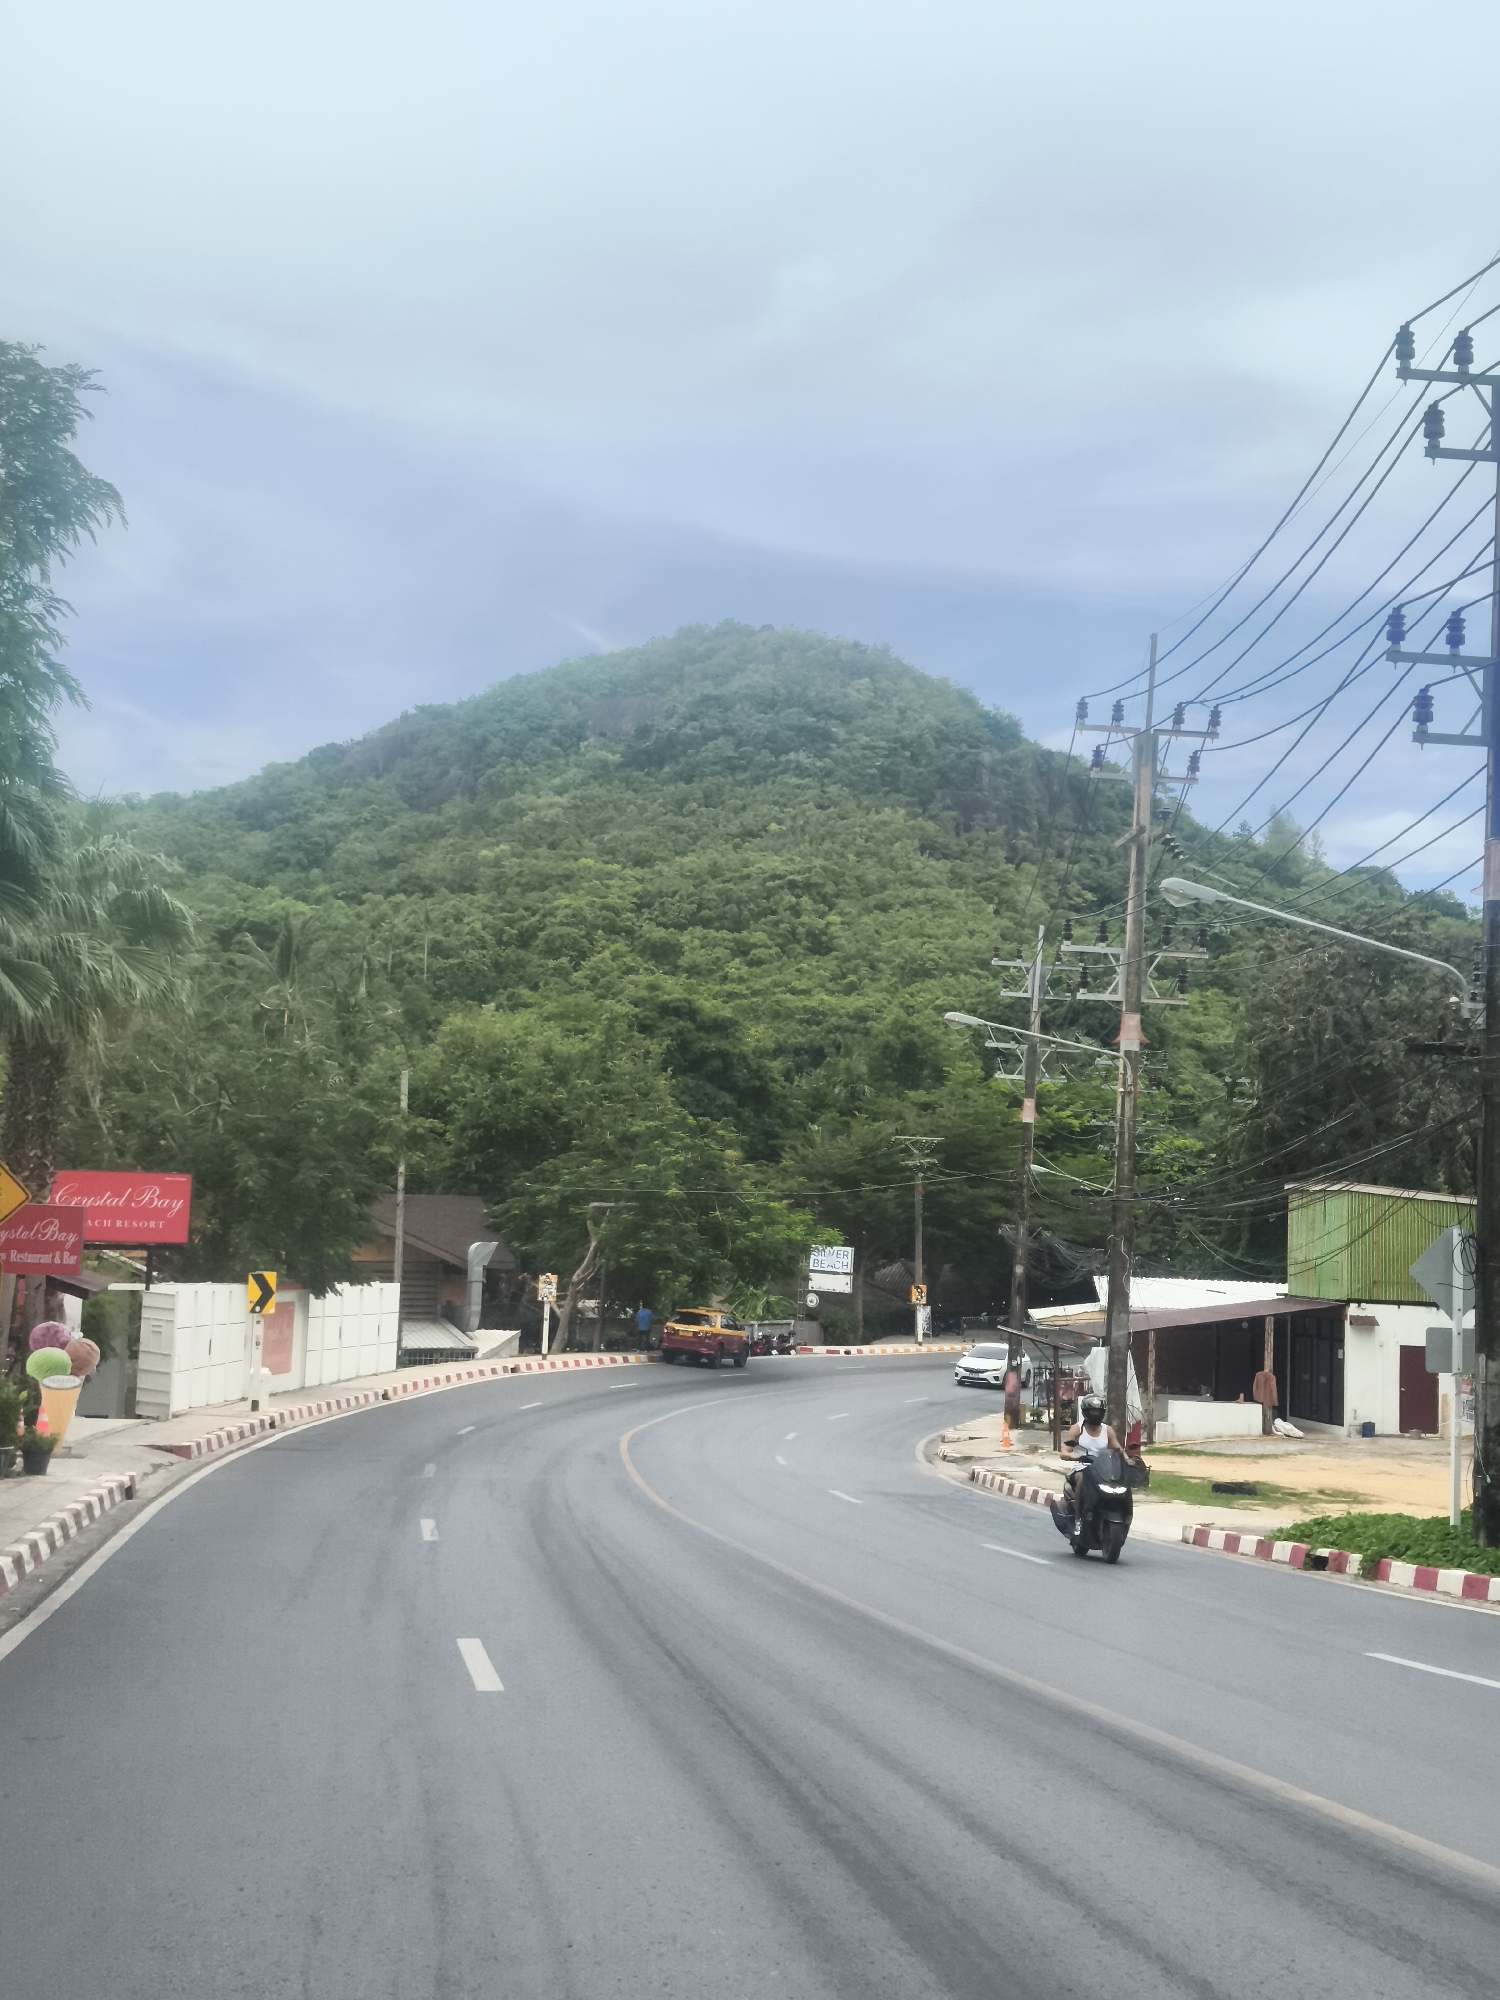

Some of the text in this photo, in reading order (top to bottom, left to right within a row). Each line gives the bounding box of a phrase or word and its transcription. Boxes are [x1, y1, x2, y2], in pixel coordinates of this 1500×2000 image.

[56, 1183, 184, 1218] Crystal Bay
[85, 1219, 165, 1229] ACH RESORT
[0, 1218, 79, 1250] ystal Bay
[10, 1249, 53, 1264] Restaurant
[54, 1251, 61, 1264] &
[63, 1251, 78, 1264] Bar
[813, 1259, 849, 1269] BEACH
